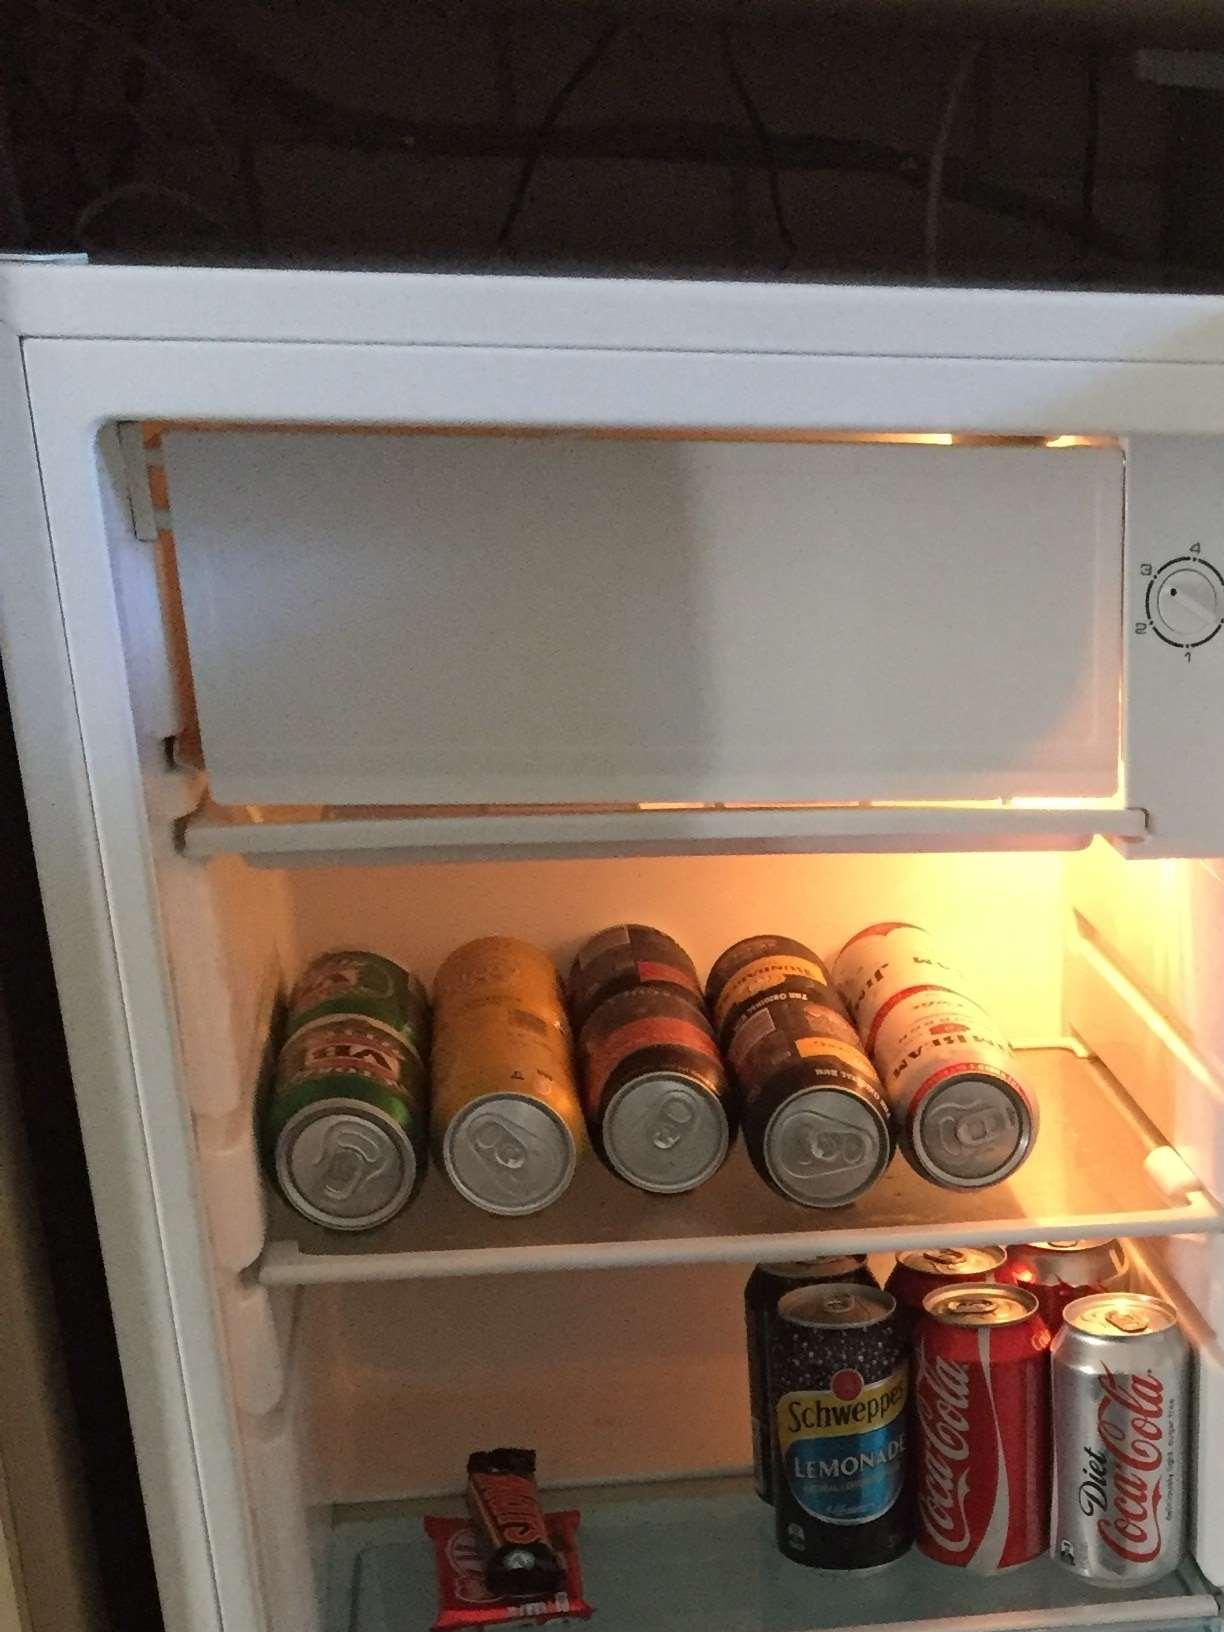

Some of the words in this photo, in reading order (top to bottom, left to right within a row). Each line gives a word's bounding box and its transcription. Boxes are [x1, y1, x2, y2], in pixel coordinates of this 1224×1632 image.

[1189, 542, 1201, 554] 4
[1140, 563, 1153, 576] 3
[1134, 622, 1148, 635] 2
[1184, 651, 1192, 663] 1
[793, 1432, 906, 1479] LEMONADE
[1097, 1359, 1164, 1564] Coca-Cola
[1078, 1446, 1109, 1517] Diet
